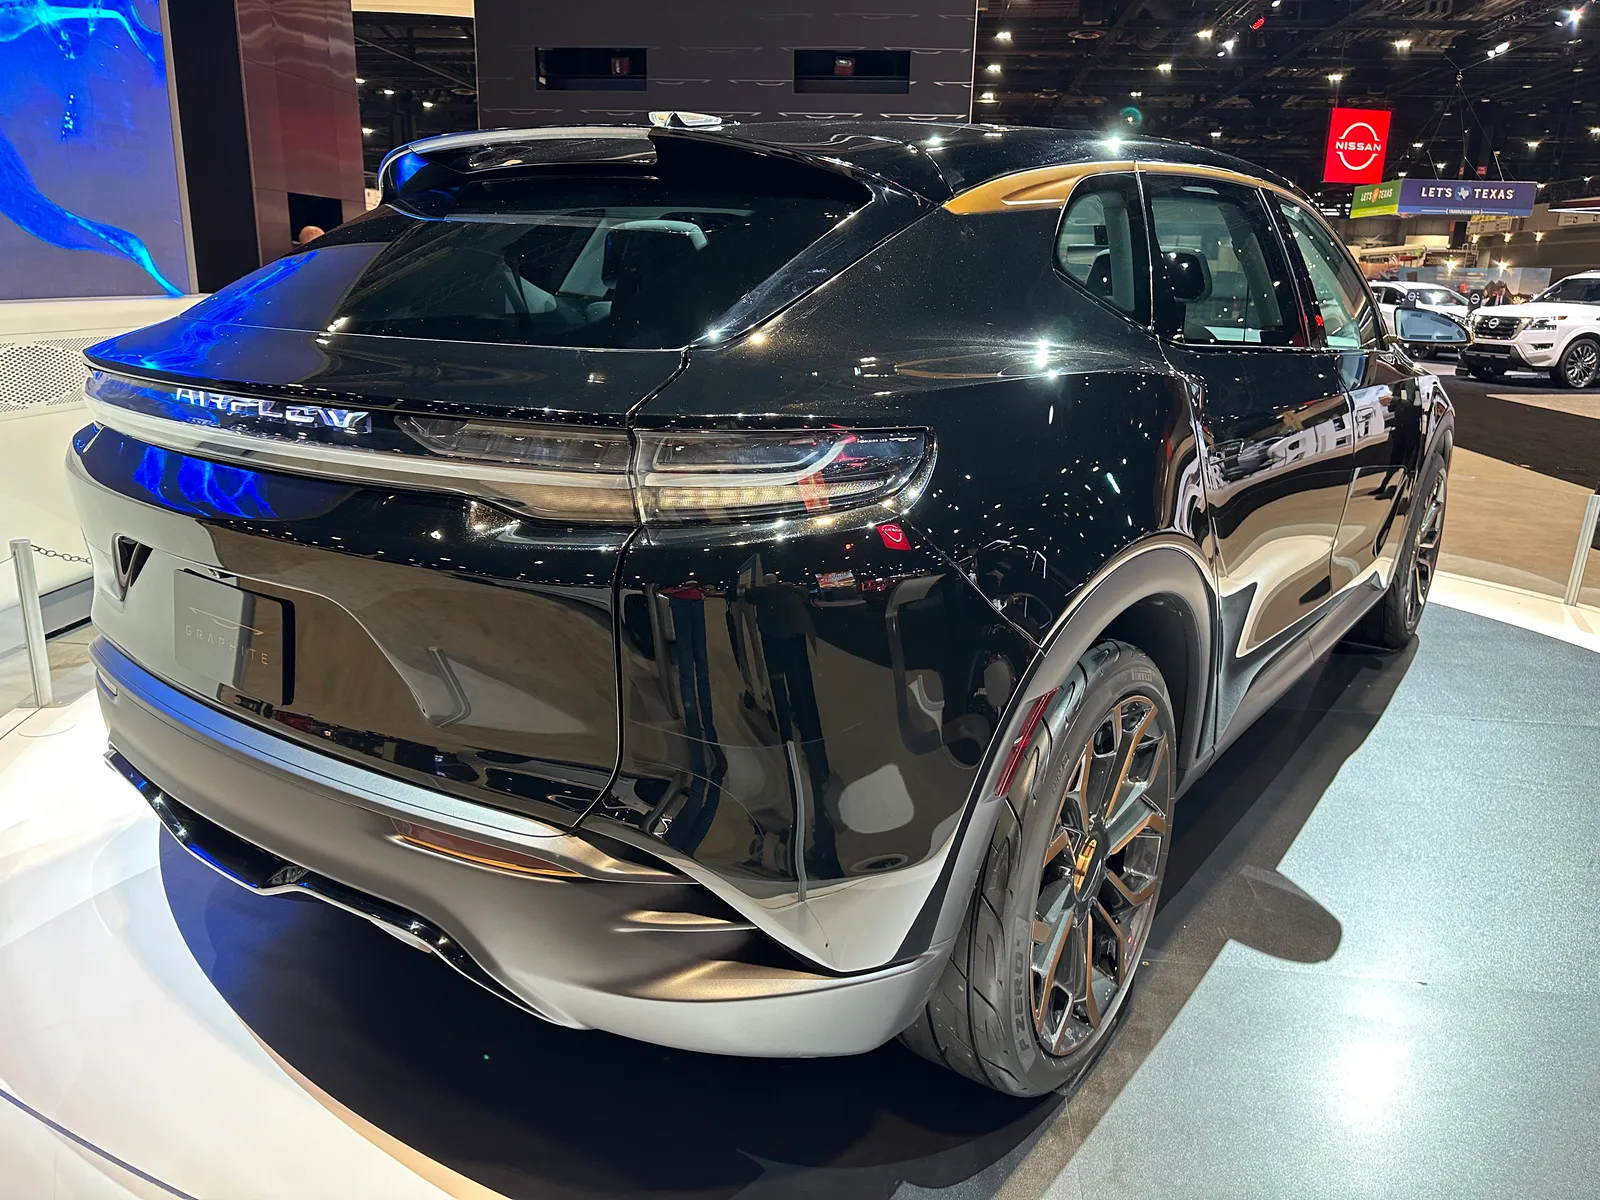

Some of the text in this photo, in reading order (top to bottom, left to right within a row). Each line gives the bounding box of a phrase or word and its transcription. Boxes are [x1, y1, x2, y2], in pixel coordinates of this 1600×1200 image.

[1335, 141, 1382, 152] NISSAN
[1421, 187, 1514, 200] LET'S TEXAS
[185, 624, 268, 665] GRAPHITE
[1014, 948, 1027, 1033] ZERO
